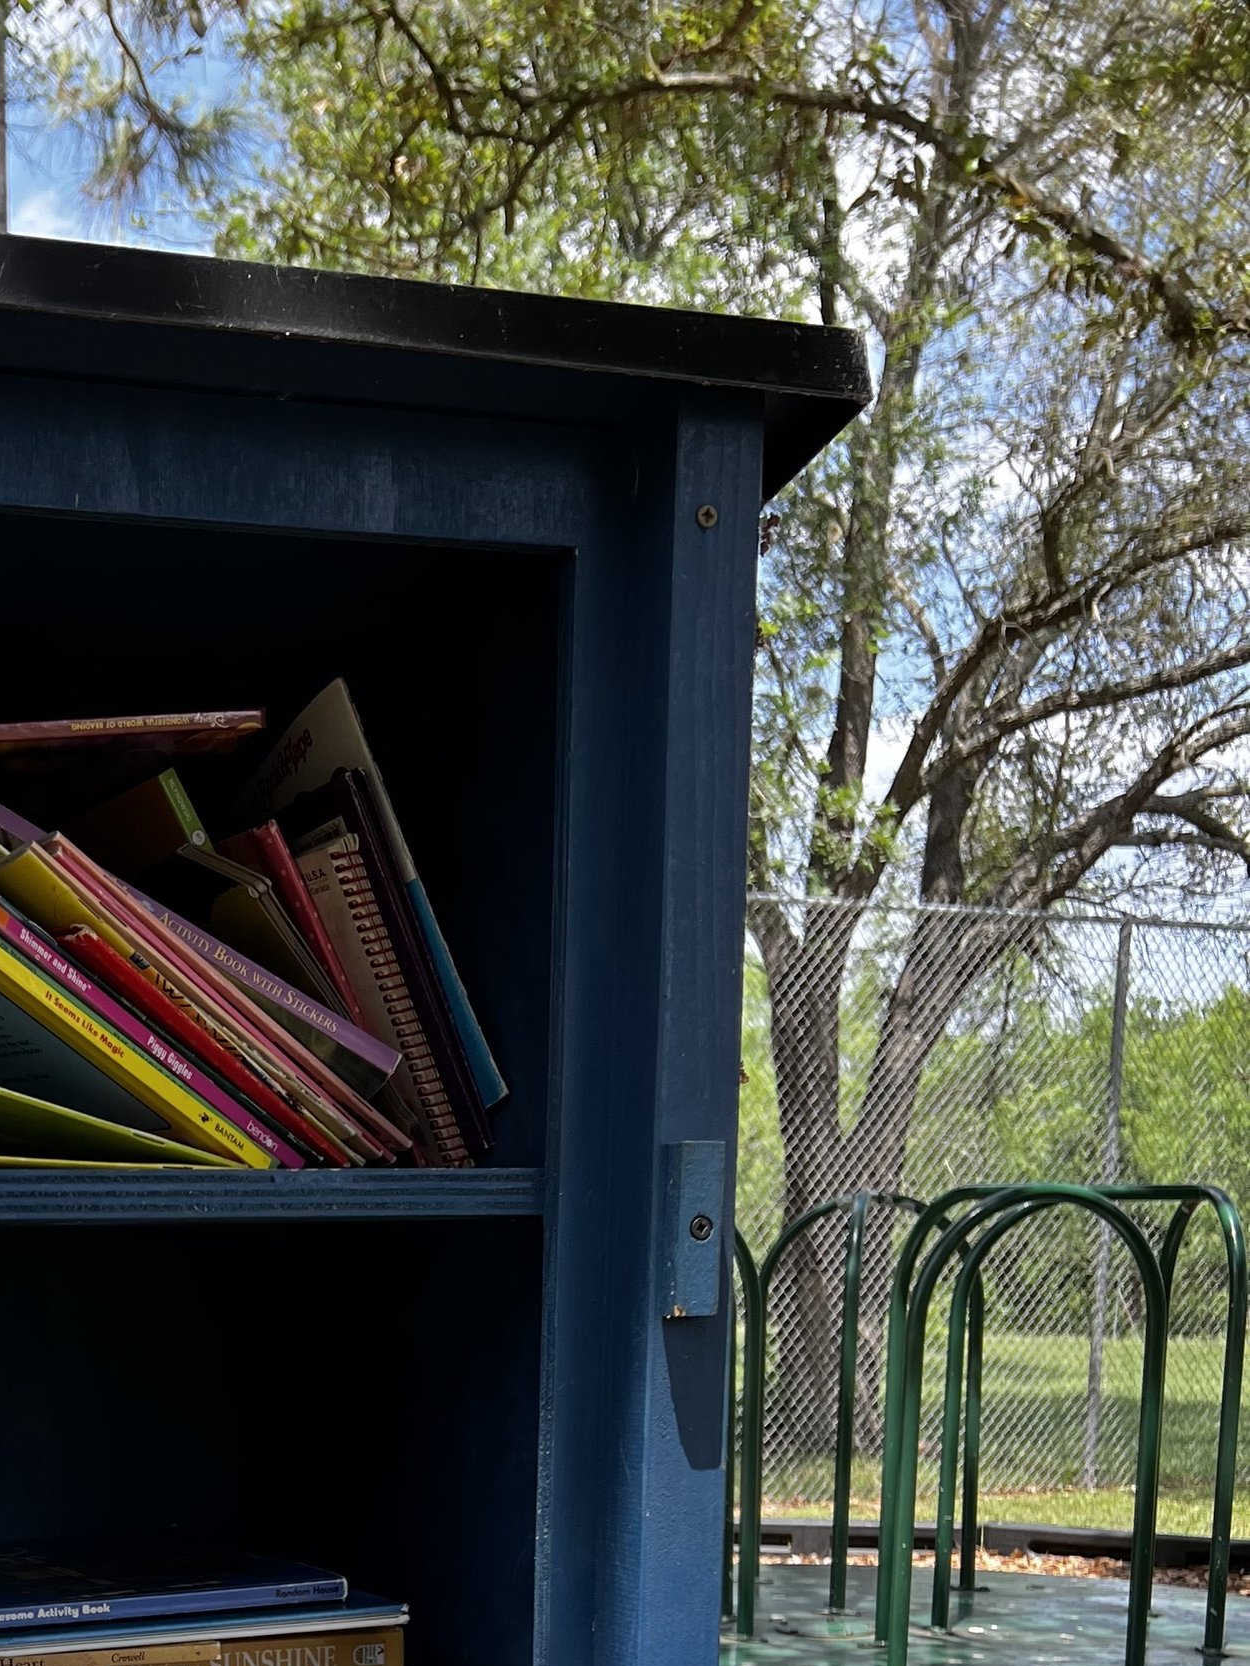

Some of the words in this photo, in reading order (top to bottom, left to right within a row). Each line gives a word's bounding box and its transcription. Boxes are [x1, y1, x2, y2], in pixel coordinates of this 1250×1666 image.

[71, 721, 104, 732] READING
[118, 719, 144, 728] WORLD
[19, 927, 52, 962] Shimmer
[52, 953, 68, 976] and
[159, 912, 212, 952] ACTIVITY
[213, 945, 249, 977] BOOK
[252, 972, 283, 999] WITH
[284, 990, 339, 1034] STICKERS
[45, 990, 54, 1002] It
[53, 996, 81, 1023] Seems
[81, 1015, 99, 1039] Like
[100, 1034, 126, 1059] Magic
[146, 1035, 168, 1064] Piggy
[166, 1052, 193, 1081] Giggles
[214, 1122, 246, 1151] BANTAM
[246, 1120, 279, 1153] bendon
[37, 1605, 80, 1619] Activity
[82, 1603, 111, 1615] Book
[275, 1586, 311, 1598] Random
[313, 1584, 340, 1596] House
[111, 1651, 146, 1664] Crowell
